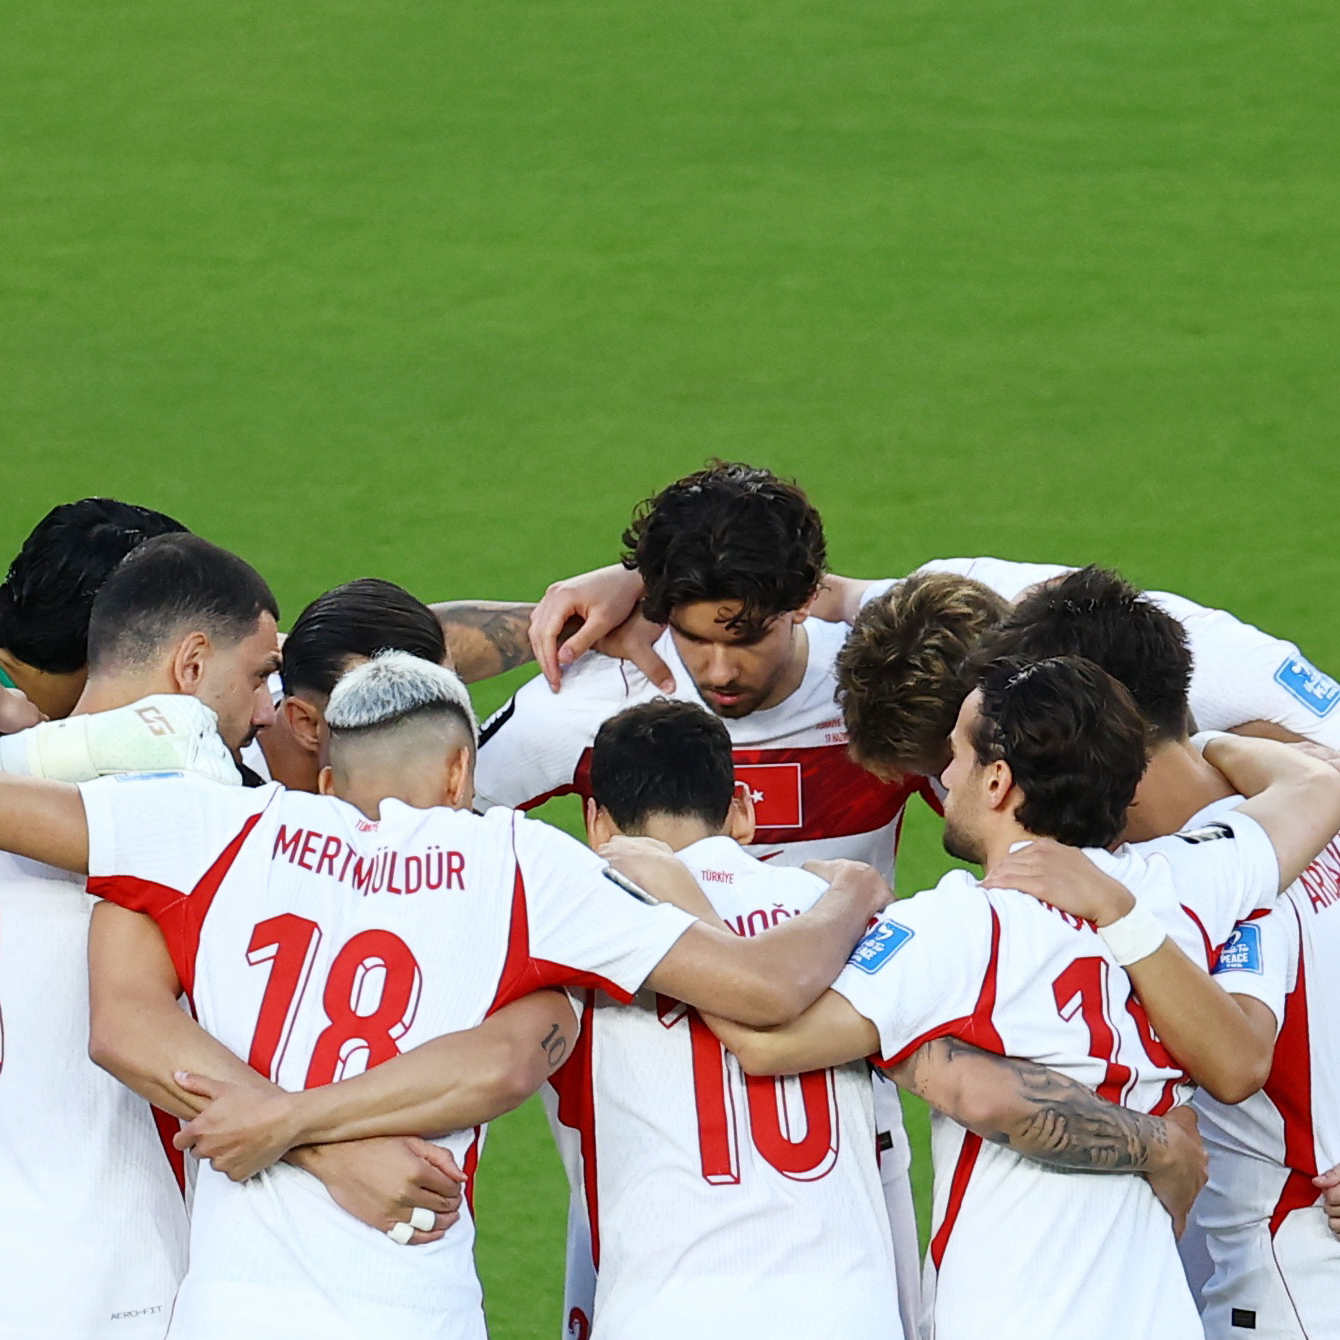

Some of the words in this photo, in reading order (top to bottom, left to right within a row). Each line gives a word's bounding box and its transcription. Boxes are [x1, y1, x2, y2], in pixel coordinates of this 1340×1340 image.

[271, 823, 357, 883] MERT
[352, 844, 466, 897] MÜLDÜR
[245, 911, 423, 1091] 18
[655, 991, 841, 1186] 10
